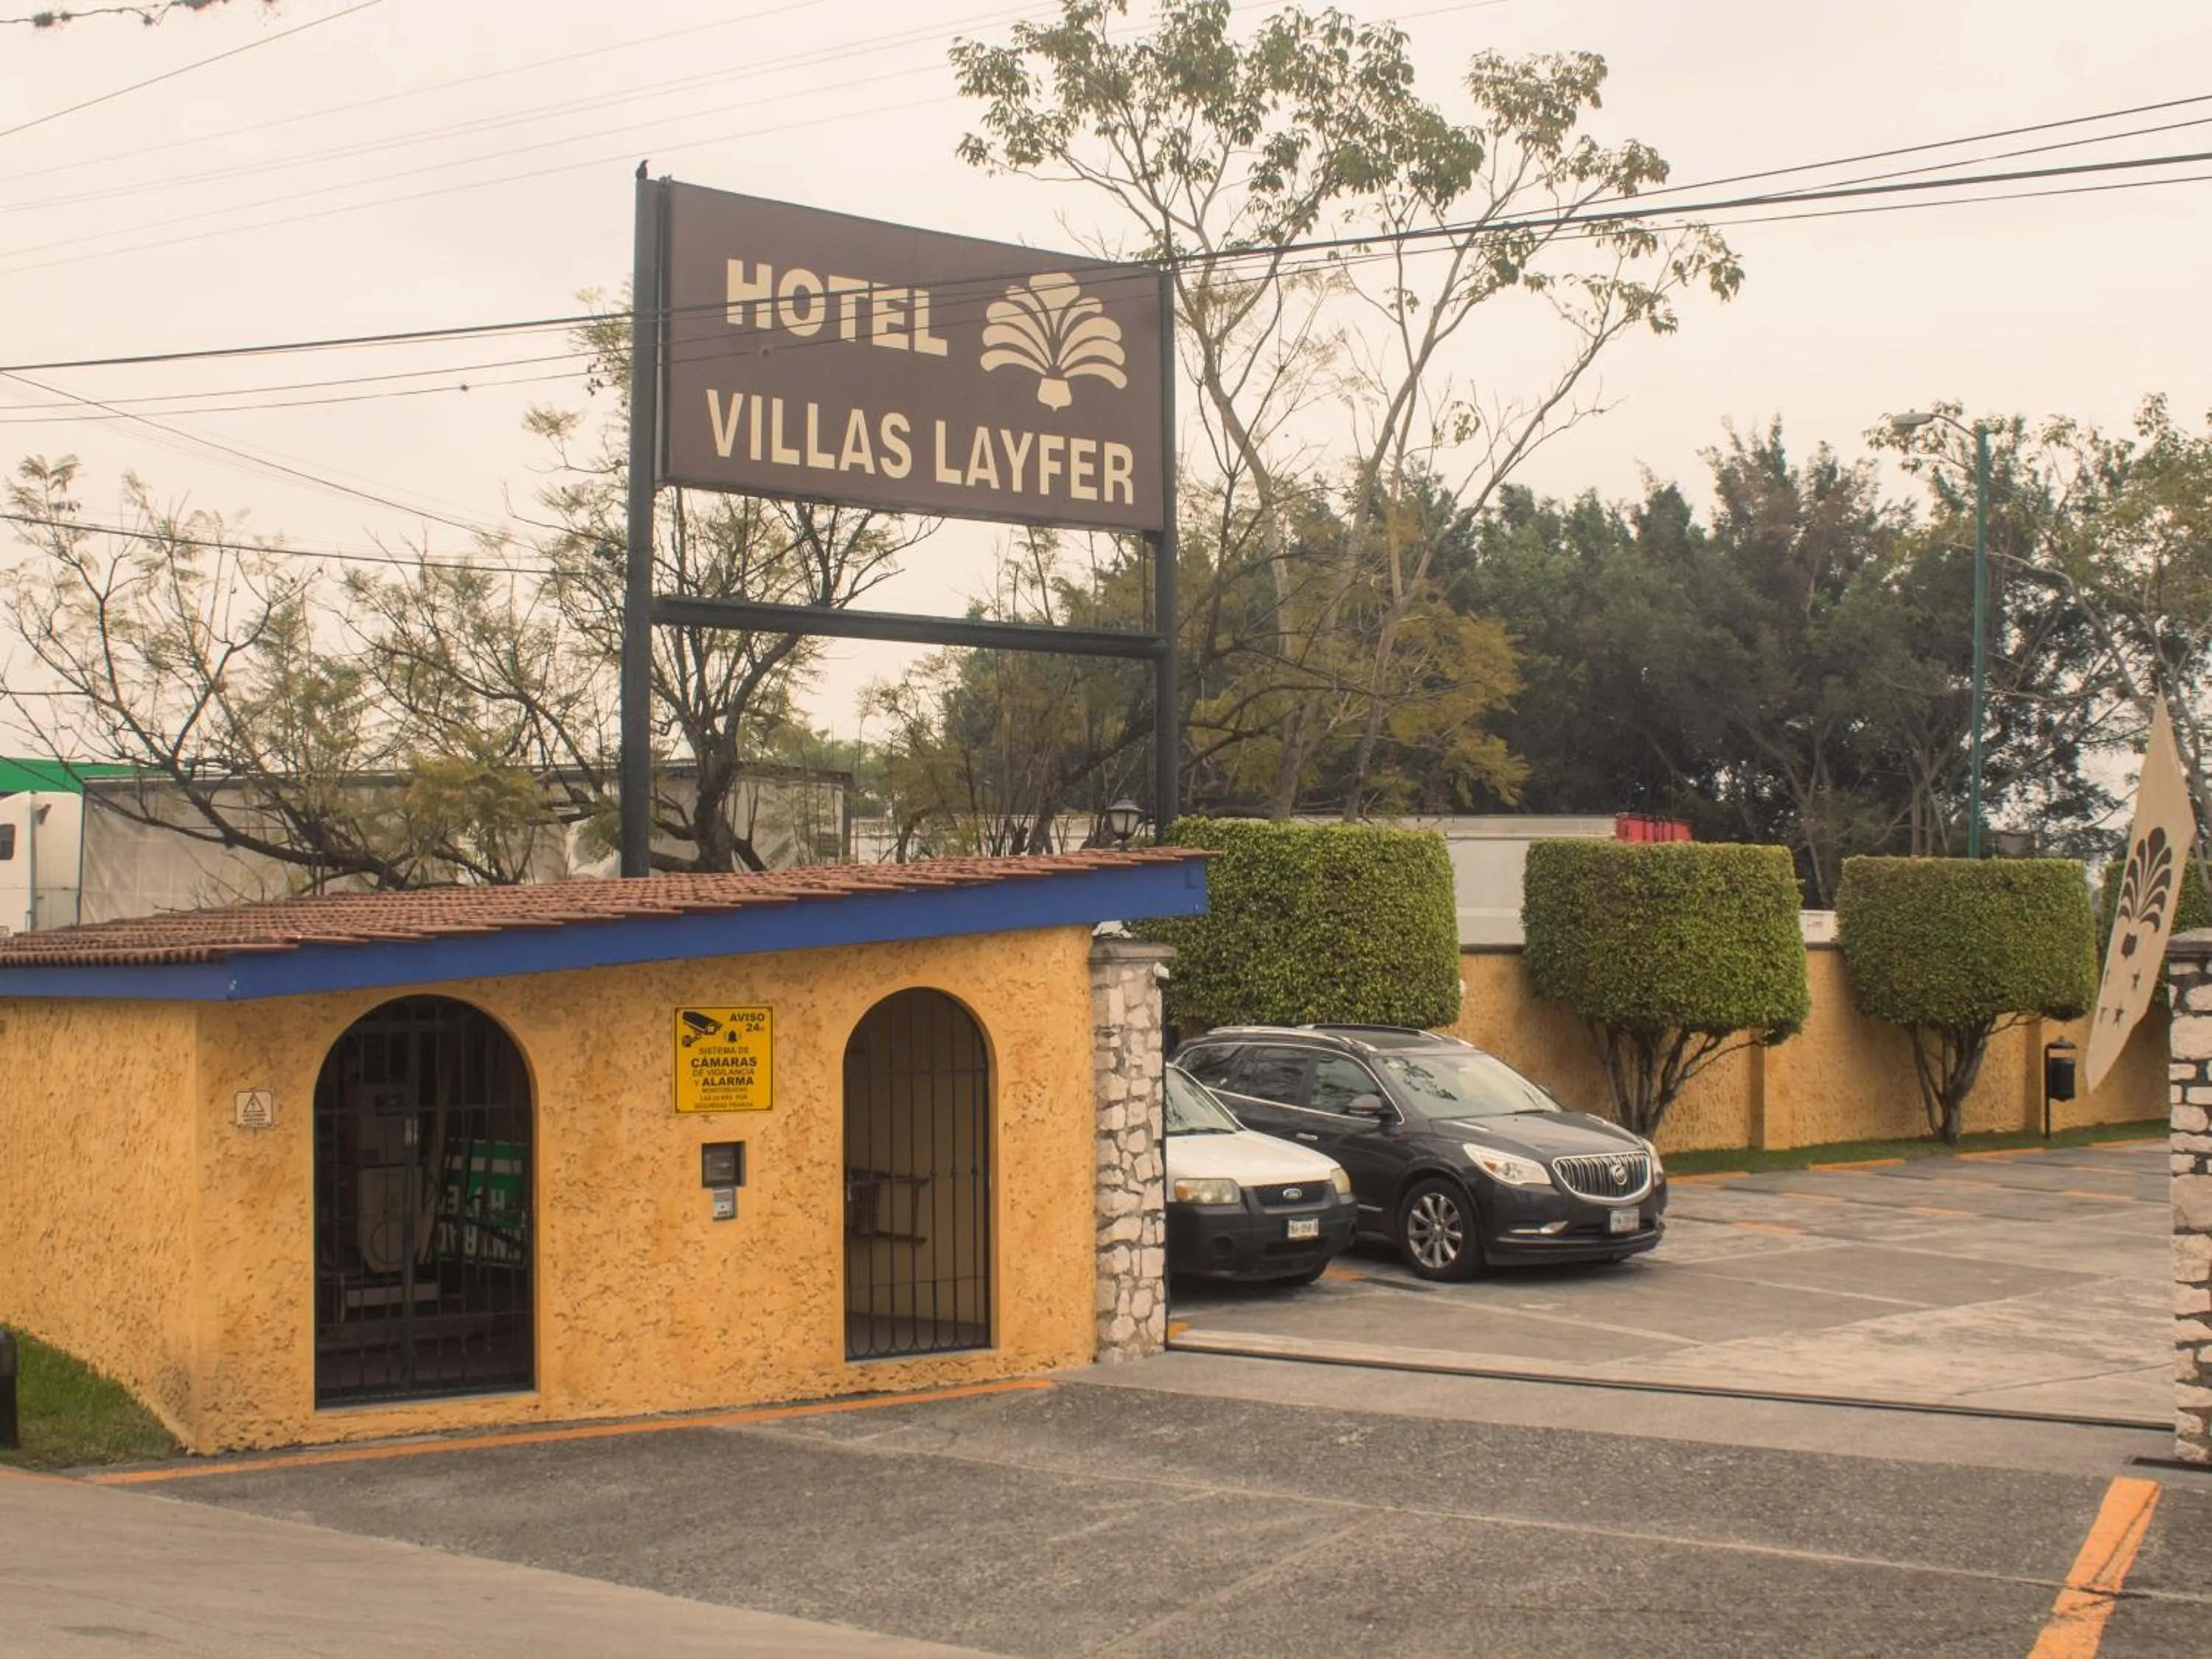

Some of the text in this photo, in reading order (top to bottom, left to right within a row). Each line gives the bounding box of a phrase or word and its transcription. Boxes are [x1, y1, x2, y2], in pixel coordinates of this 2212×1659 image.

[726, 259, 948, 357] HOTEL
[706, 389, 1134, 505] VILLAS LAYFER
[730, 1013, 765, 1022] AVISO
[702, 1077, 754, 1086] ALARMA
